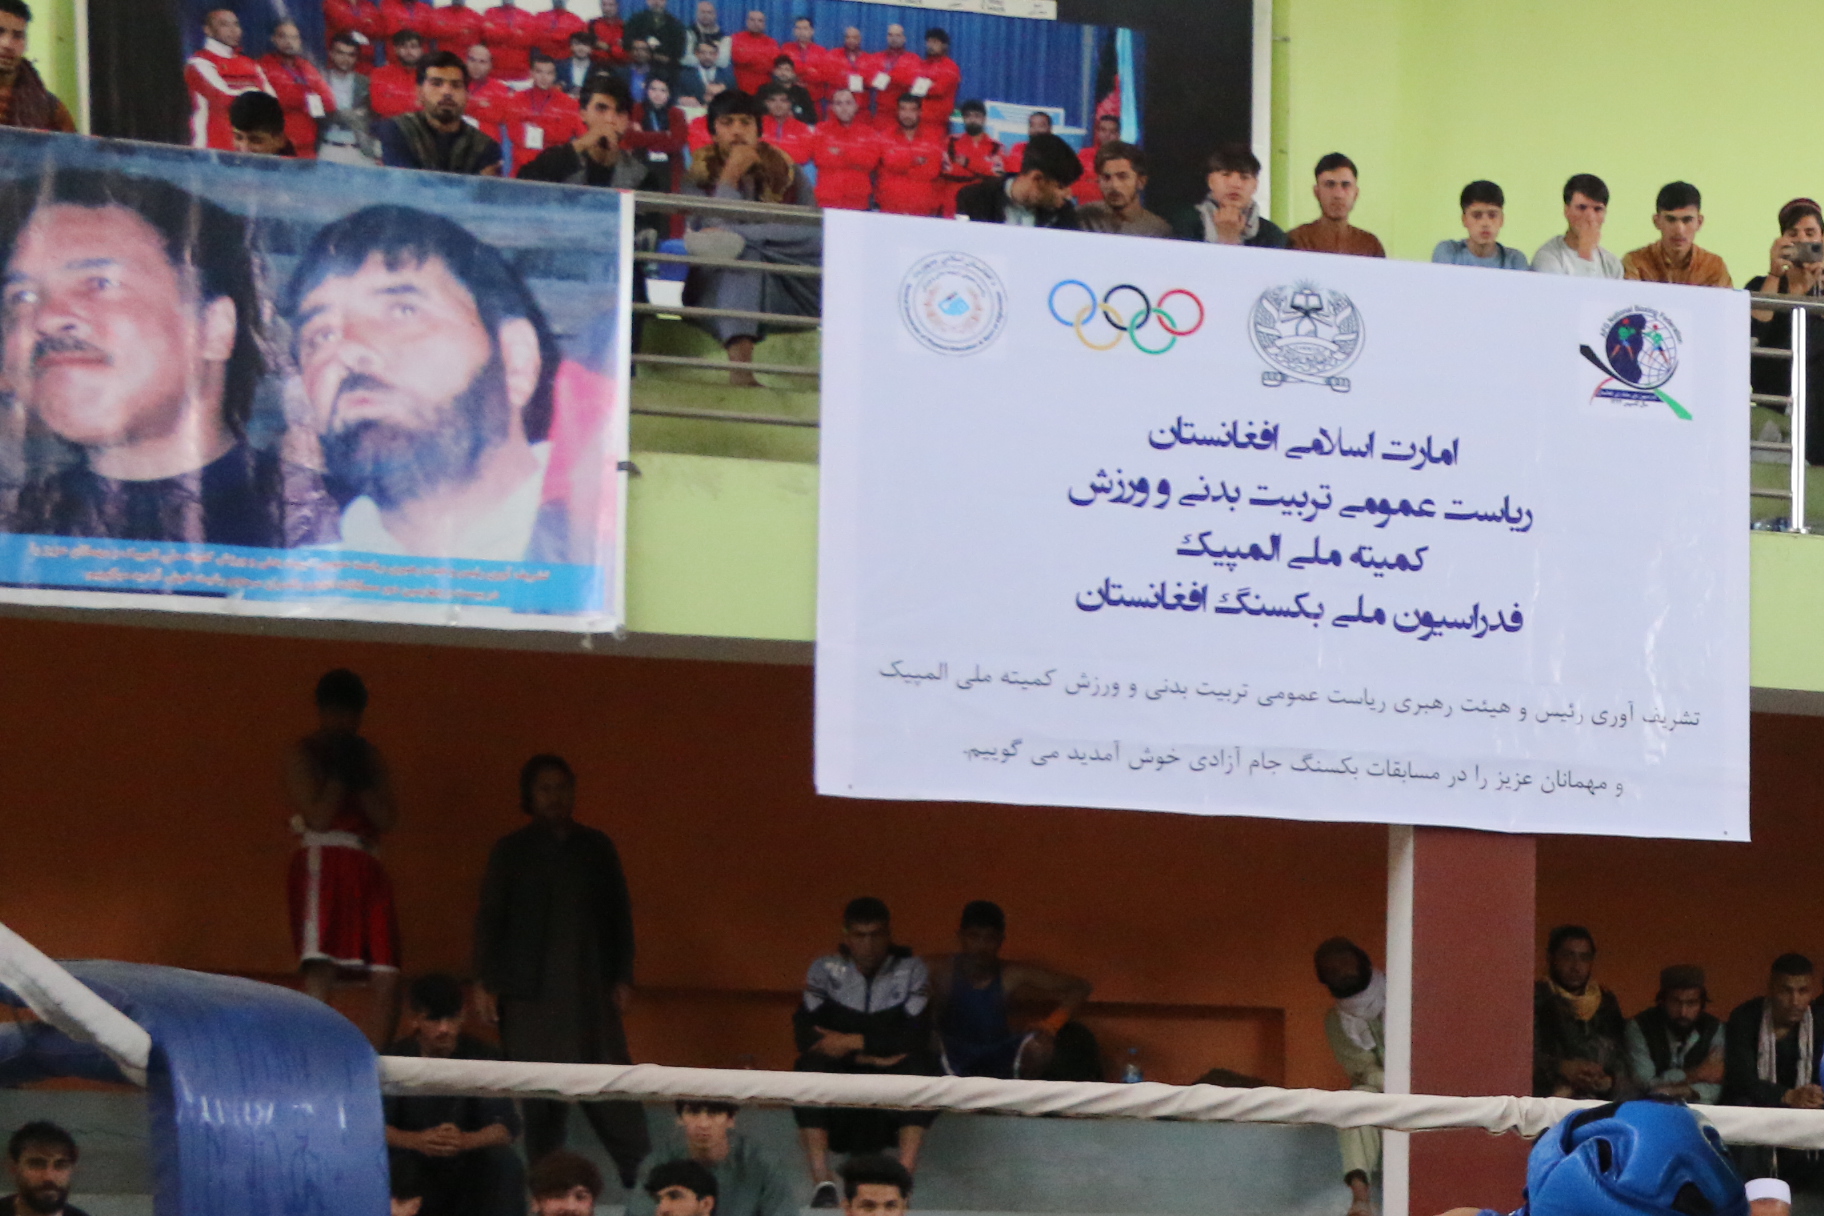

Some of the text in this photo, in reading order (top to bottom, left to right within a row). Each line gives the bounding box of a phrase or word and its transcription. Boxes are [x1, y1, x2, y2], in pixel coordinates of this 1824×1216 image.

[1148, 415, 1280, 451] افغانستان
[1381, 434, 1460, 471] امارت
[1249, 484, 1333, 522] تربیت
[1443, 494, 1534, 533] ریاست
[1176, 530, 1281, 573] المپیک
[1349, 544, 1429, 578] کمیته
[1075, 577, 1209, 613] افغانستان
[1214, 586, 1325, 629] بکسنگ
[1393, 601, 1524, 642] فدراسیون
[879, 660, 949, 687] المپیک
[956, 664, 993, 690] ملی
[1000, 668, 1057, 690] کمیته
[1065, 671, 1120, 697] ورزش
[1128, 681, 1138, 698] و
[1144, 678, 1188, 701] بدنی
[1195, 681, 1249, 705] تربیت
[1257, 689, 1319, 707] عمومی
[1327, 687, 1386, 712] ریاست
[1393, 697, 1453, 716] رهبری
[1518, 706, 1527, 720] و
[1535, 702, 1584, 725] رئیس
[1591, 700, 1634, 729] آوری
[1641, 706, 1701, 732] تشریف
[1030, 749, 1060, 766] می
[1067, 739, 1121, 765] آمدید
[1128, 746, 1180, 770] خوش
[1188, 746, 1241, 776] آزادی
[1249, 750, 1282, 776] جام
[1290, 753, 1359, 781] بکسنگ
[1366, 759, 1441, 783] مسابقات
[1447, 769, 1467, 789] در
[1475, 764, 1488, 790] را
[1495, 768, 1533, 792] عزیز
[1540, 769, 1607, 795] مهمانان
[1615, 781, 1624, 797] و
